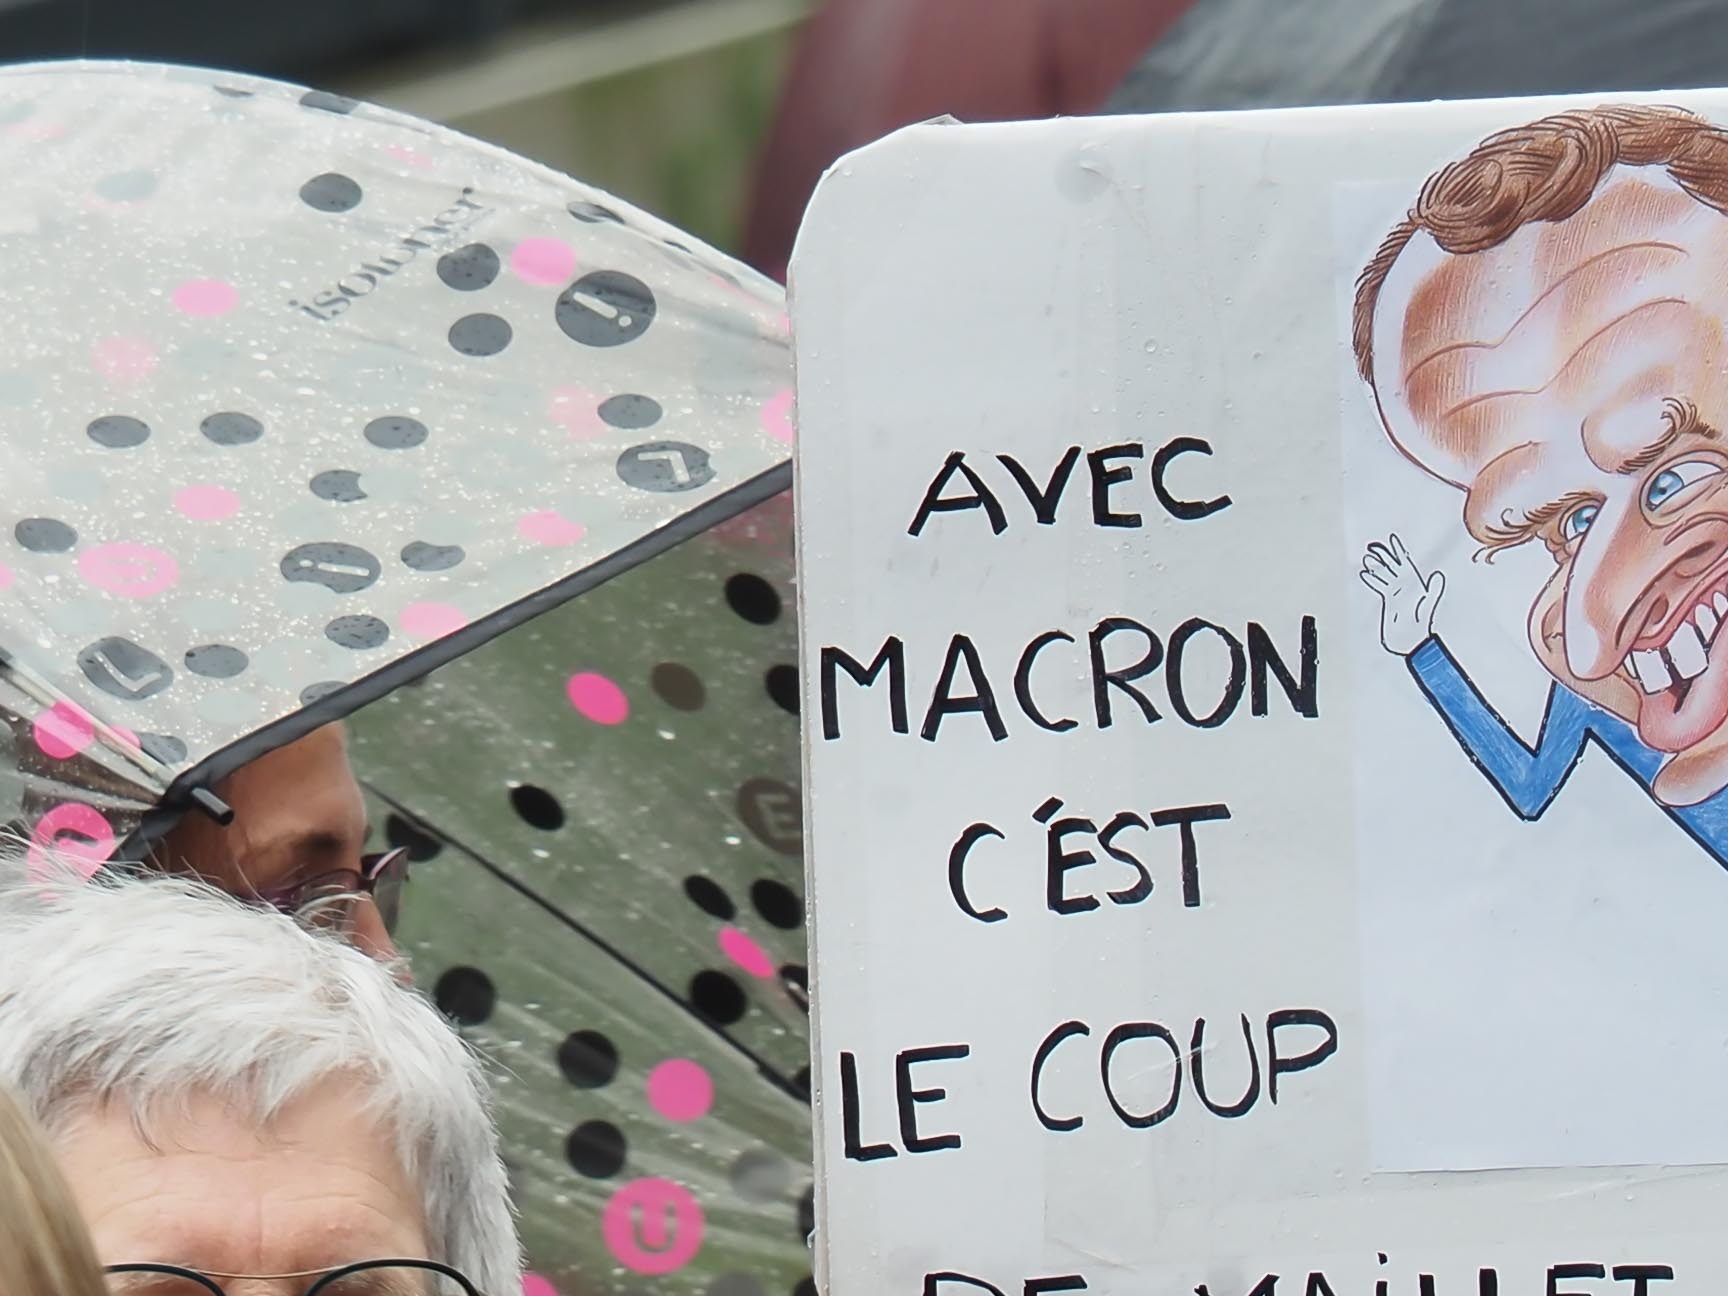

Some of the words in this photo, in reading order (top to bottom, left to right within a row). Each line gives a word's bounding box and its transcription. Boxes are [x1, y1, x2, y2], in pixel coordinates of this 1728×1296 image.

[907, 437, 1233, 536] AVEC
[820, 615, 1319, 742] MACRON
[840, 1045, 970, 1162] LE
[1031, 1009, 1338, 1132] COUP
